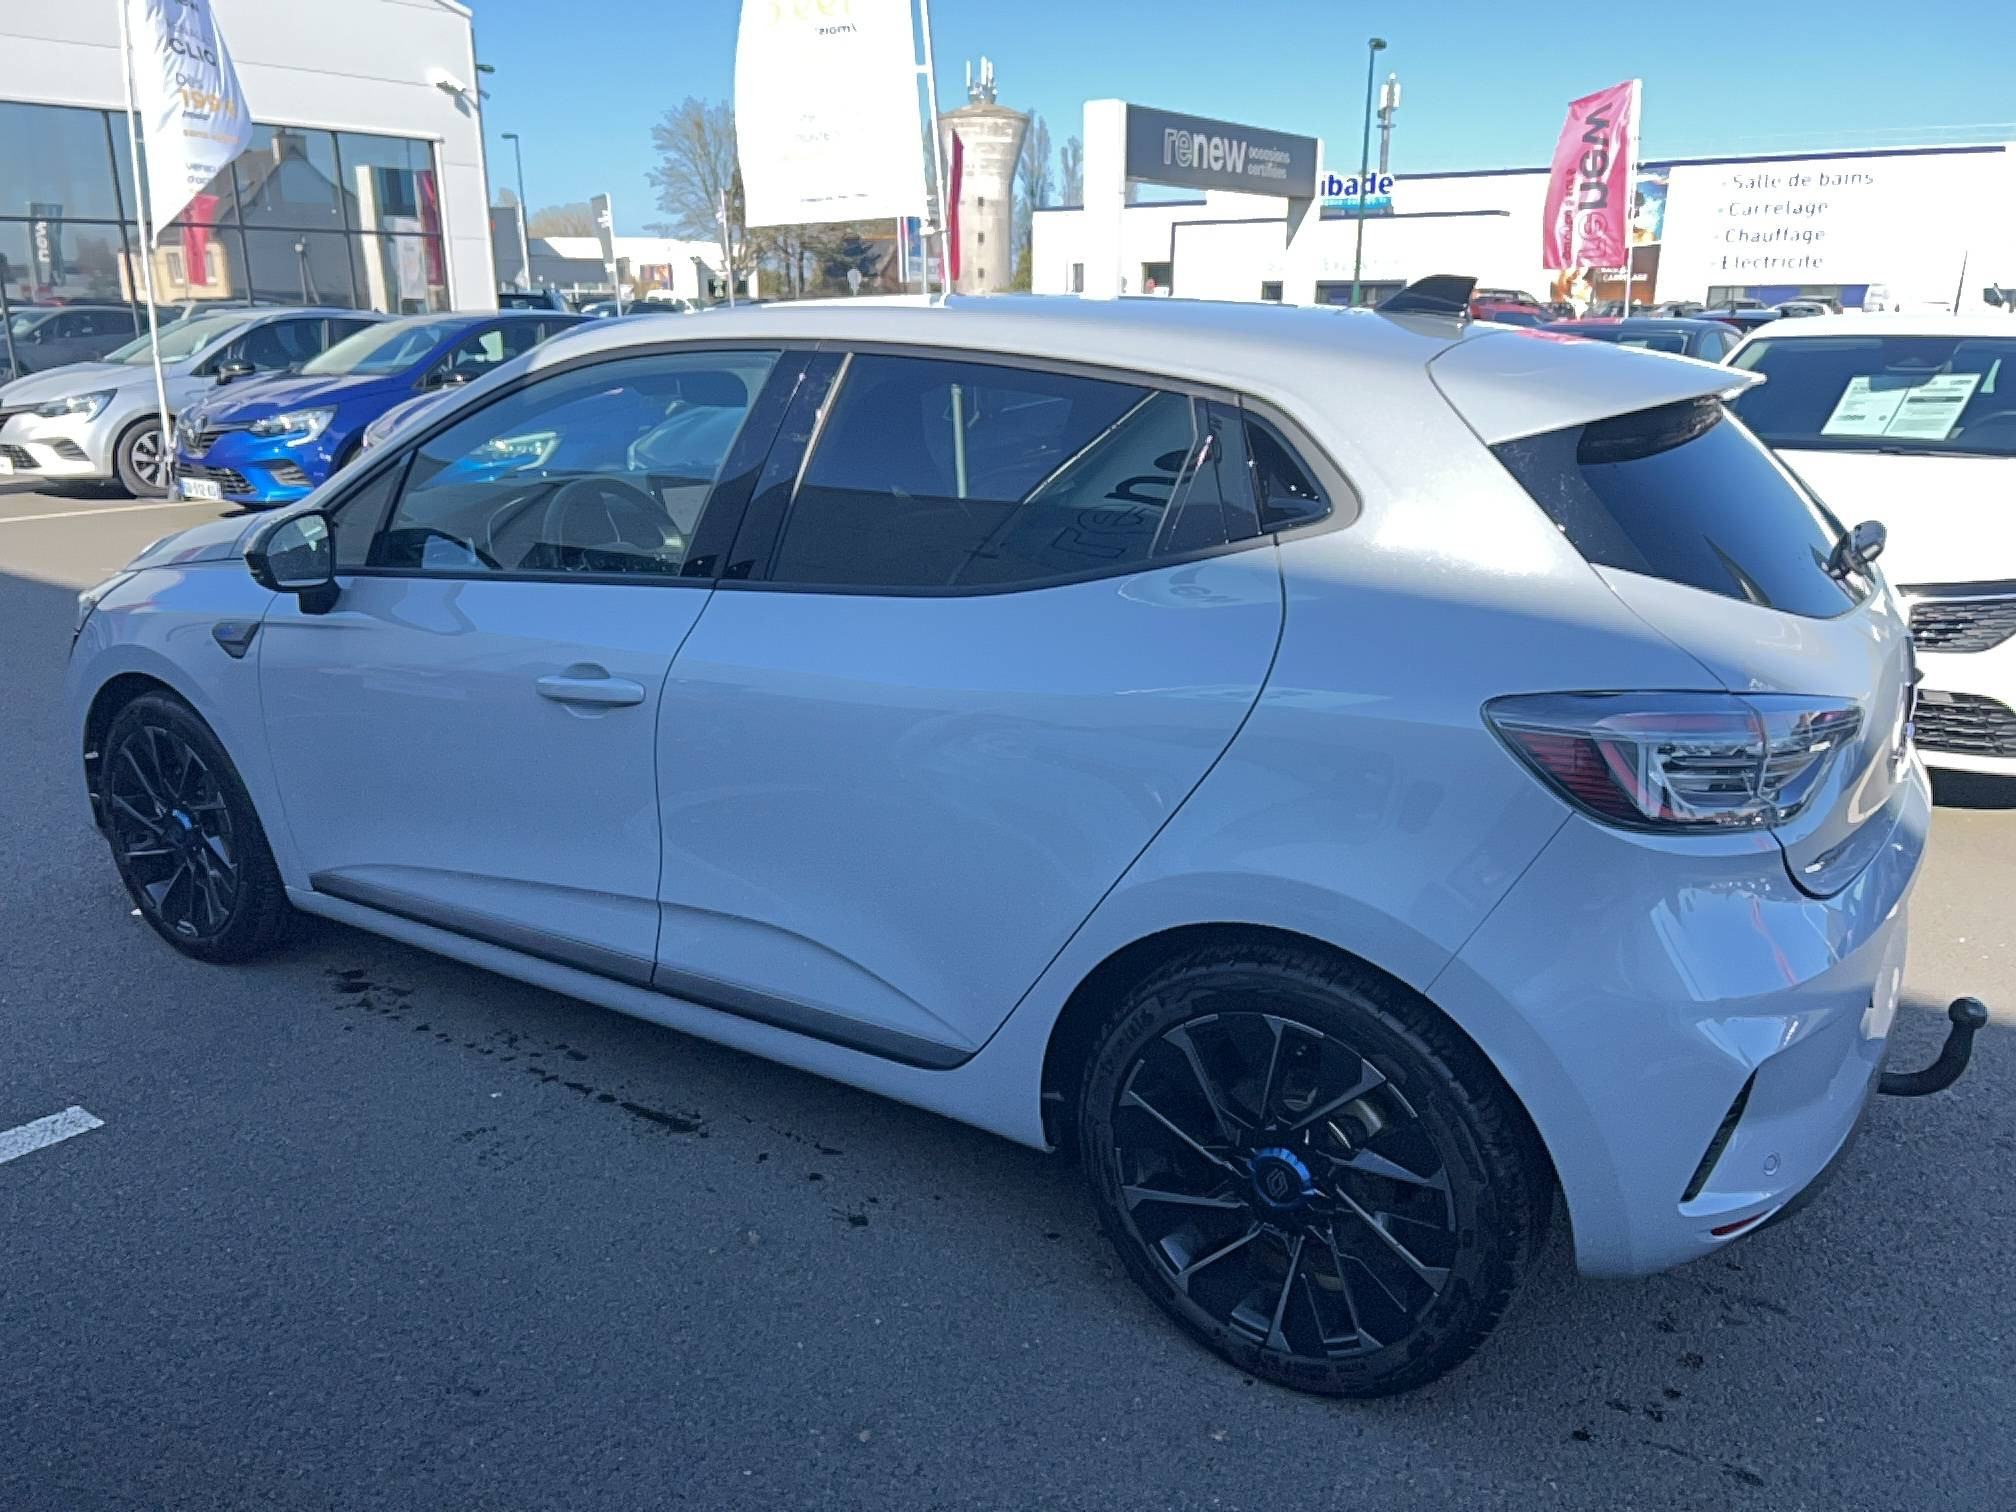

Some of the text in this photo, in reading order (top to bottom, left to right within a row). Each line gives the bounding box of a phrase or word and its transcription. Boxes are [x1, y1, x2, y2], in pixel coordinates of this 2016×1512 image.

[1163, 128, 1248, 174] renew
[1733, 172, 1874, 189] Salle de bains
[1729, 201, 1828, 218] Carrelage
[1725, 228, 1826, 244] Chauffage
